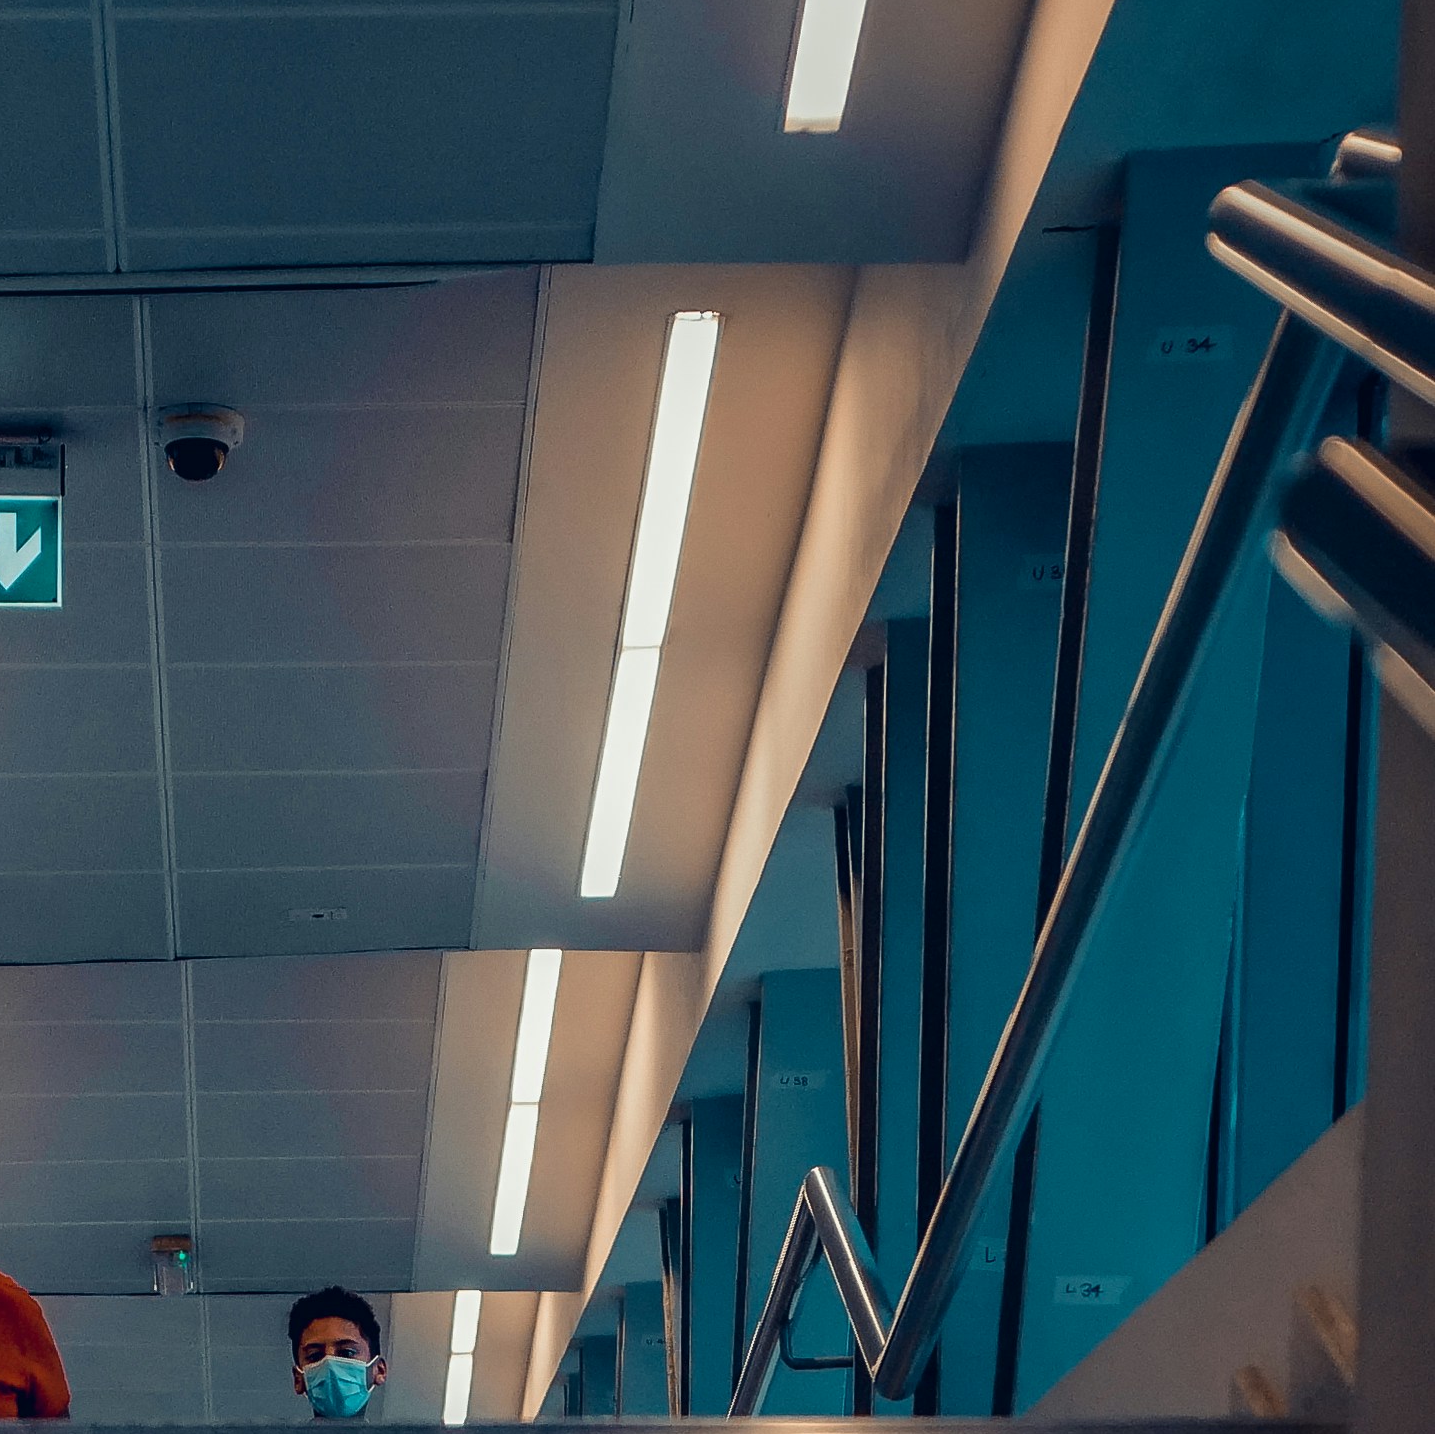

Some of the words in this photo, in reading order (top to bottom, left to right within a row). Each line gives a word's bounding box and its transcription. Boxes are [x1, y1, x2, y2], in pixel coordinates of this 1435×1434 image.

[1161, 340, 1173, 354] U
[1187, 335, 1217, 354] 34
[1032, 565, 1044, 580] U
[1080, 1282, 1104, 1298] 34
